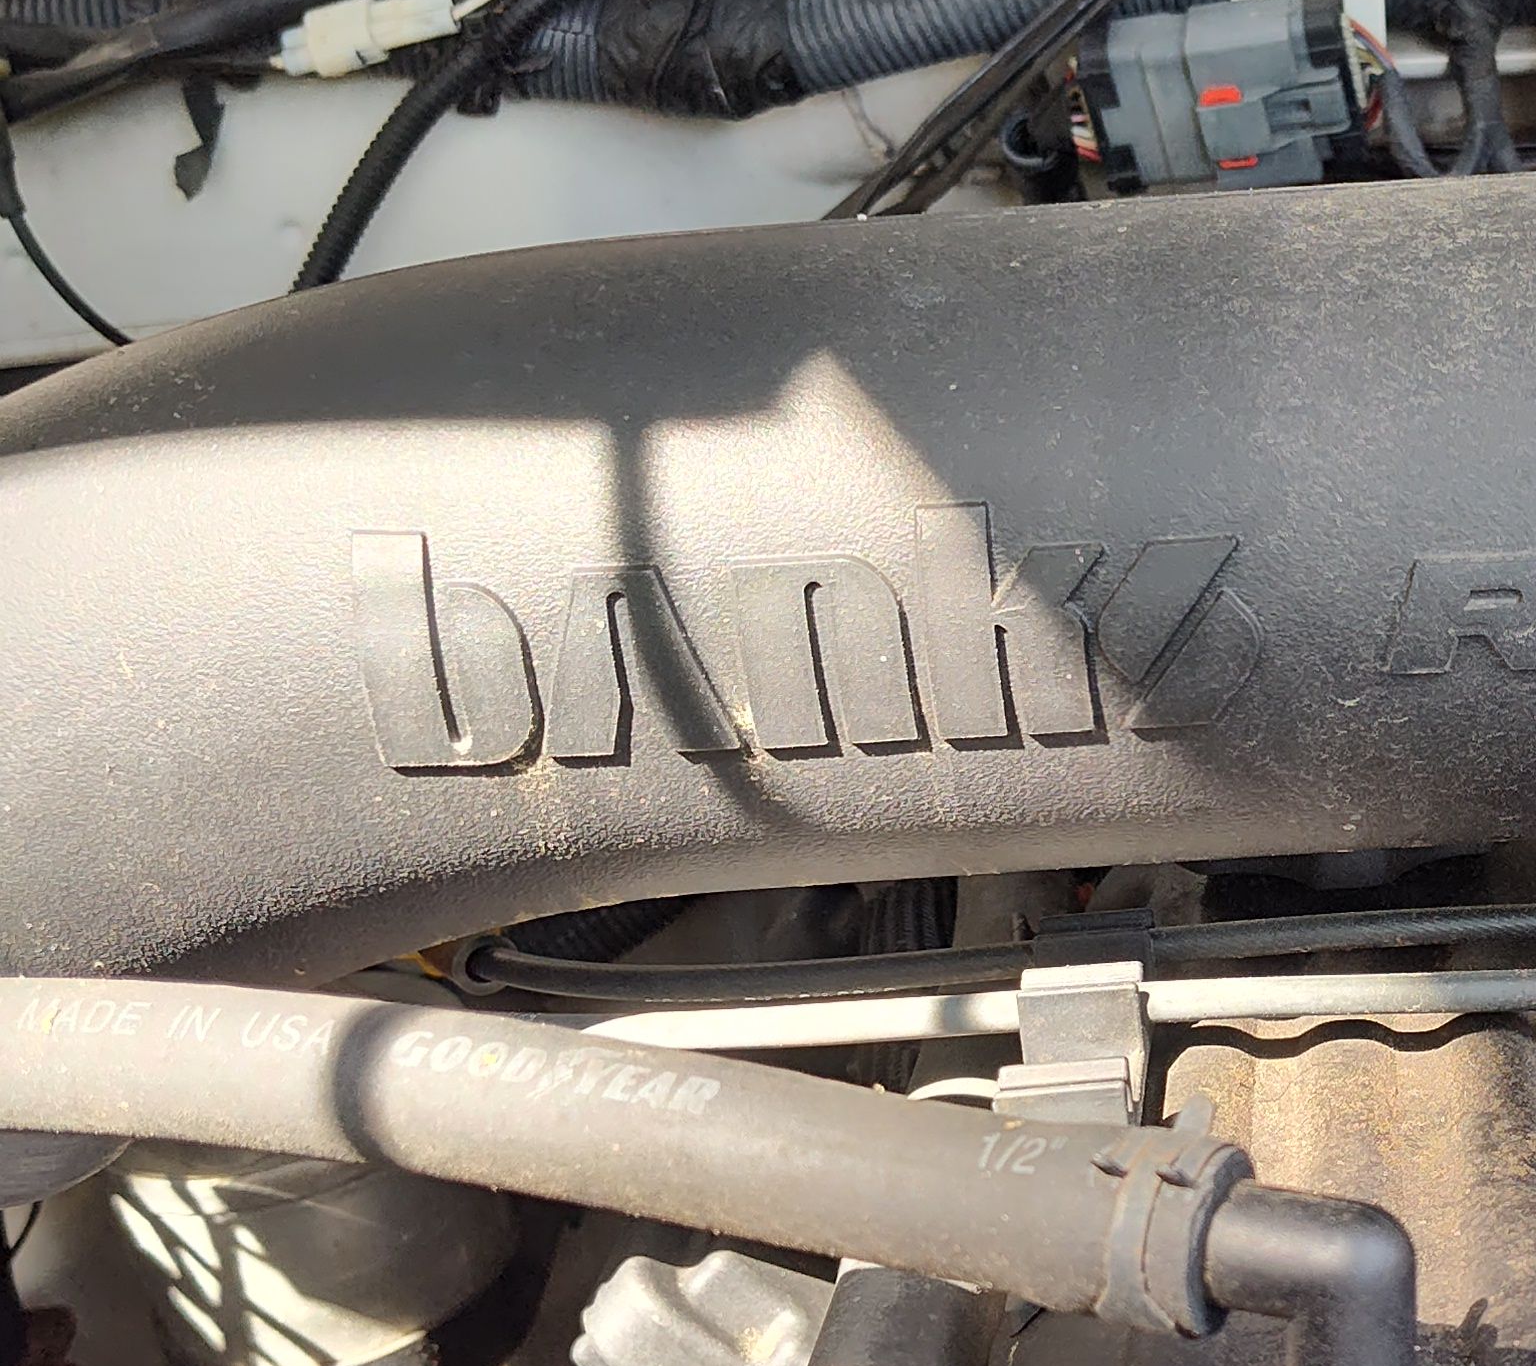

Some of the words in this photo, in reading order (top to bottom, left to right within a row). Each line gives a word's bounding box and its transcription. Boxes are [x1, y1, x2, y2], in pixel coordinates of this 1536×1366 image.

[16, 996, 153, 1037] MADE
[166, 1005, 223, 1043] IN
[240, 1011, 338, 1057] USA
[389, 1030, 722, 1116] GOODYEAR
